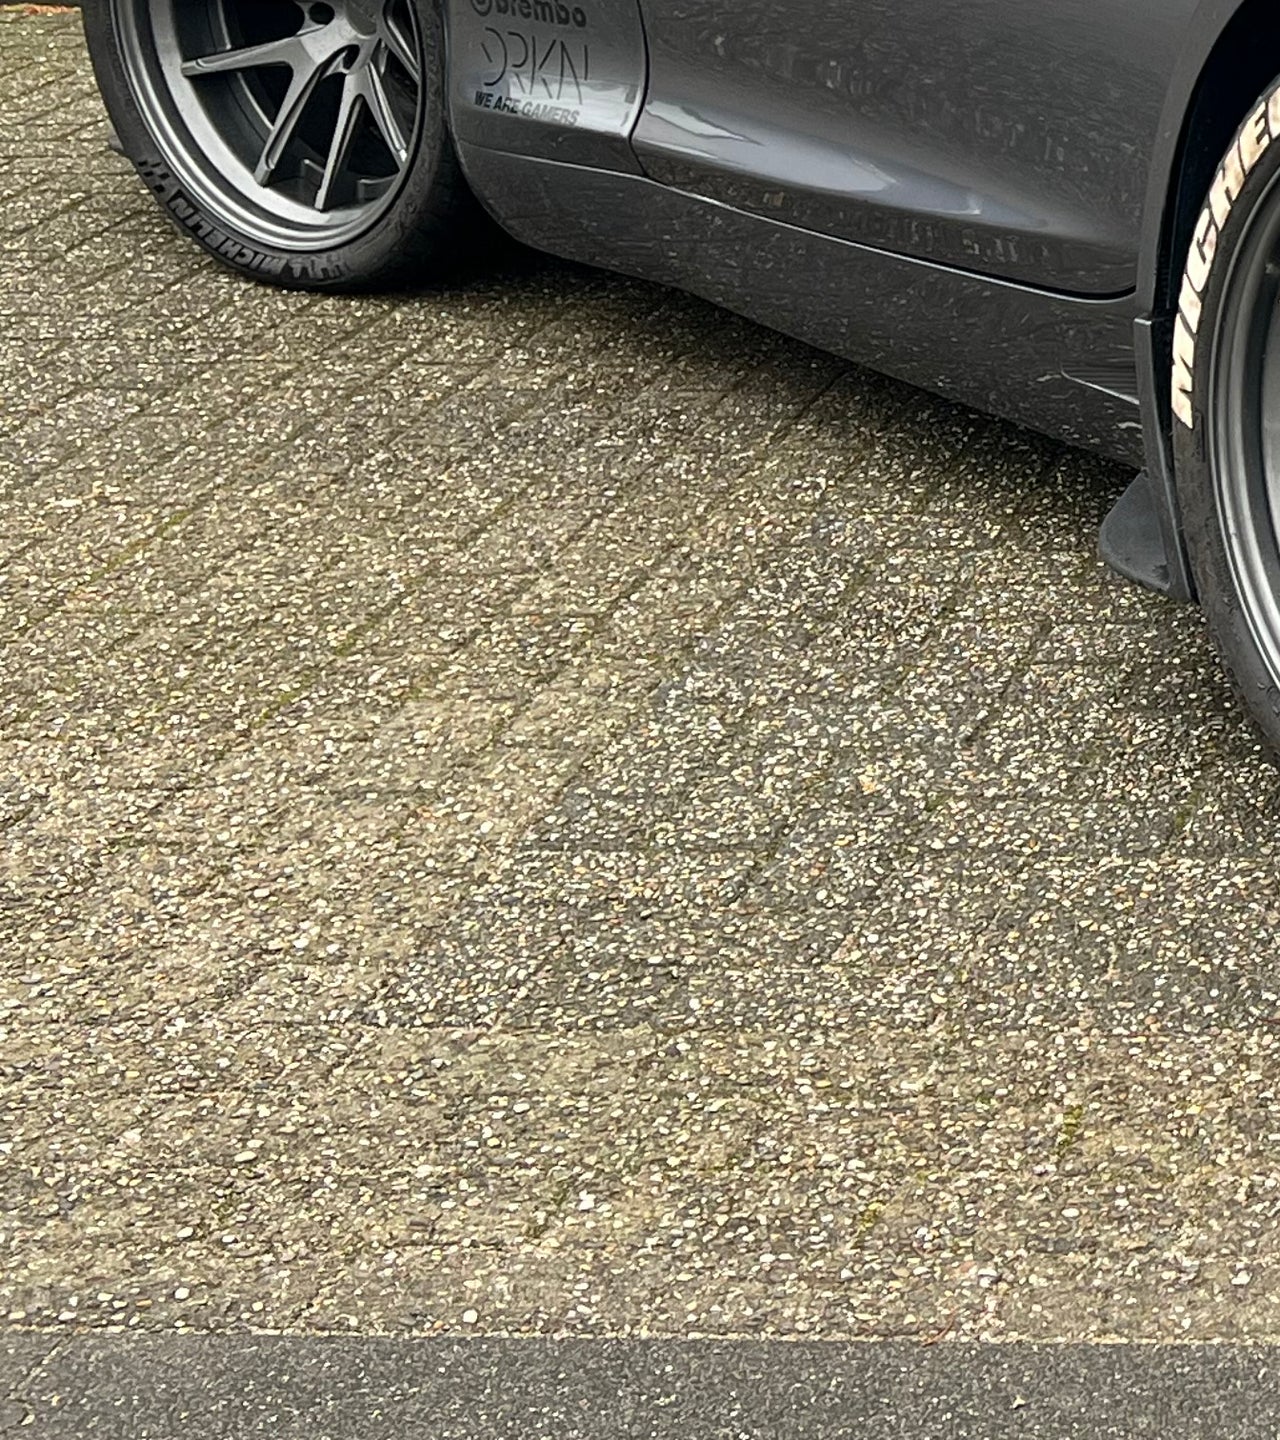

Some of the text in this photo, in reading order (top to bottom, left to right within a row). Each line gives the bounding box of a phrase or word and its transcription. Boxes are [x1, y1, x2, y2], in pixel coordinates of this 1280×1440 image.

[475, 90, 580, 127] WE ARE GAMERS
